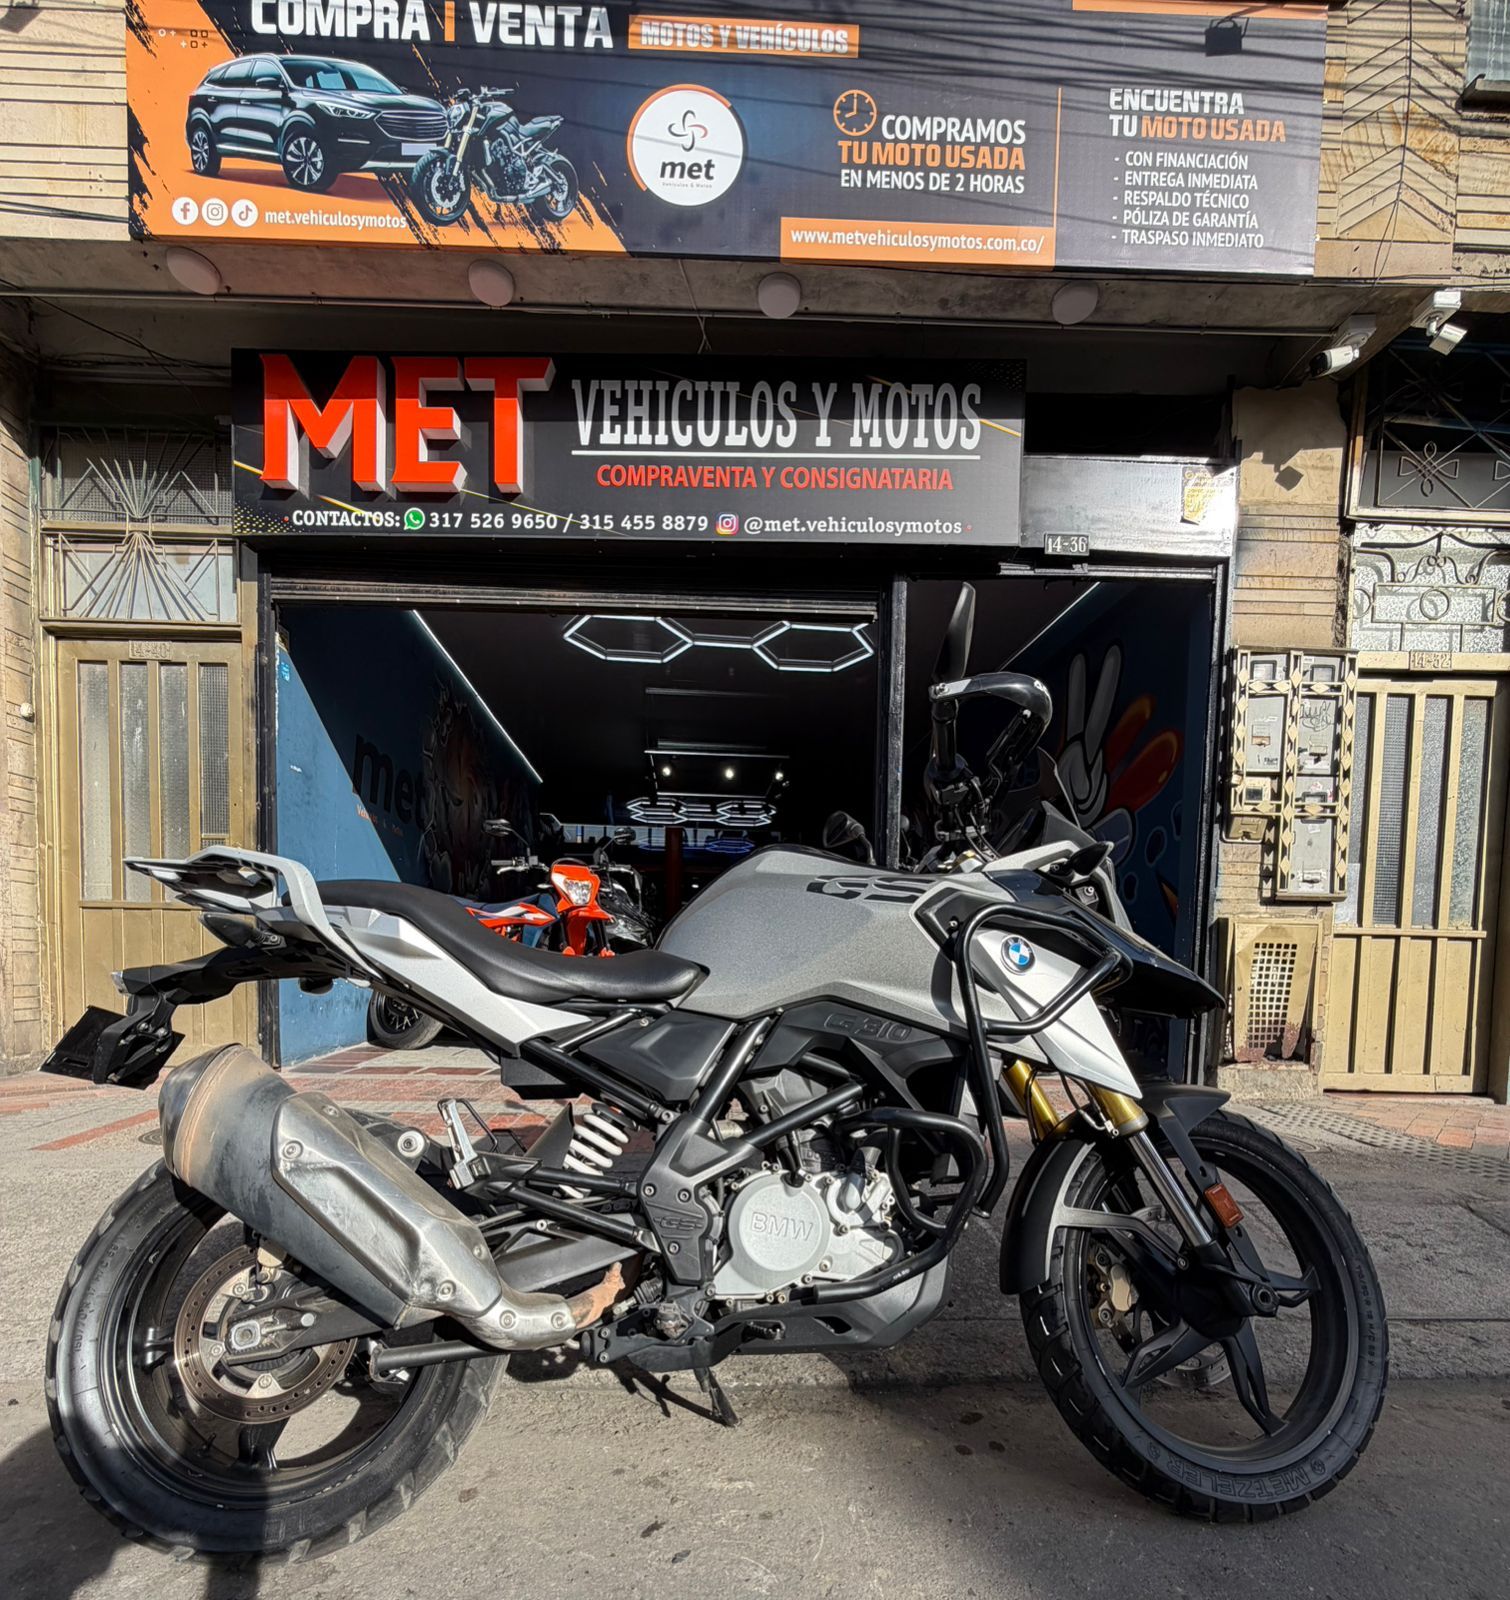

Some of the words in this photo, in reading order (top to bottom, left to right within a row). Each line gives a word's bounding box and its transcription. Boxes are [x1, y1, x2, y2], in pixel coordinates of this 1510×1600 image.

[251, 0, 431, 42] COMPRA
[470, 2, 614, 49] VENTA
[641, 22, 713, 48] MOTOS
[718, 25, 732, 49] Y
[736, 24, 849, 54] VEHÍCULOS
[1109, 88, 1245, 115] ENCUENTRA
[881, 114, 1026, 145] COMPRAMOS
[1109, 114, 1138, 137] TU
[1141, 116, 1207, 140] MOTO
[1210, 118, 1287, 143] USADA
[838, 140, 867, 165] TU
[872, 142, 941, 168] MOTO
[945, 145, 1026, 171] USADA
[1125, 151, 1153, 167] CON
[1156, 152, 1249, 170] FINANCIACIÓN
[660, 158, 716, 181] met
[841, 169, 863, 189] EN
[867, 171, 925, 191] MENOS
[929, 172, 951, 192] DE
[955, 173, 965, 192] 2
[969, 174, 1025, 194] HORAS
[1125, 171, 1185, 188] ENTREGA
[1188, 173, 1259, 190] INMEDIATA
[1124, 190, 1191, 208] RESPALDO
[1194, 190, 1250, 209] TÉCNICO
[265, 208, 408, 232] met.vehiculosymotos
[1123, 208, 1170, 226] PÓLIZA
[1172, 211, 1190, 227] DE
[1192, 212, 1259, 229] GARANTÍA
[790, 229, 1045, 255] www.metvehiculosymotos.com.co/
[1122, 229, 1189, 246] TRASPASO
[1192, 231, 1264, 249] INMEDIATO
[259, 353, 556, 494] MET
[572, 379, 797, 448] VEHICULOS
[812, 381, 838, 448] Y
[850, 382, 982, 450] MOTOS
[596, 464, 757, 489] COMPRAVENTA
[761, 466, 777, 489] Y
[780, 466, 955, 491] CONSIGNATARIA
[292, 510, 401, 528] CONTACTOS:
[429, 513, 467, 529] 317
[470, 513, 505, 530] 526
[511, 513, 558, 530] 9650
[580, 514, 614, 531] 315
[620, 514, 656, 531] 455
[662, 515, 709, 532] 8879
[743, 515, 963, 537] @met.vehiculosymotos
[1047, 535, 1088, 553] 14-36
[806, 876, 938, 904] GS
[751, 1211, 814, 1242] BMW
